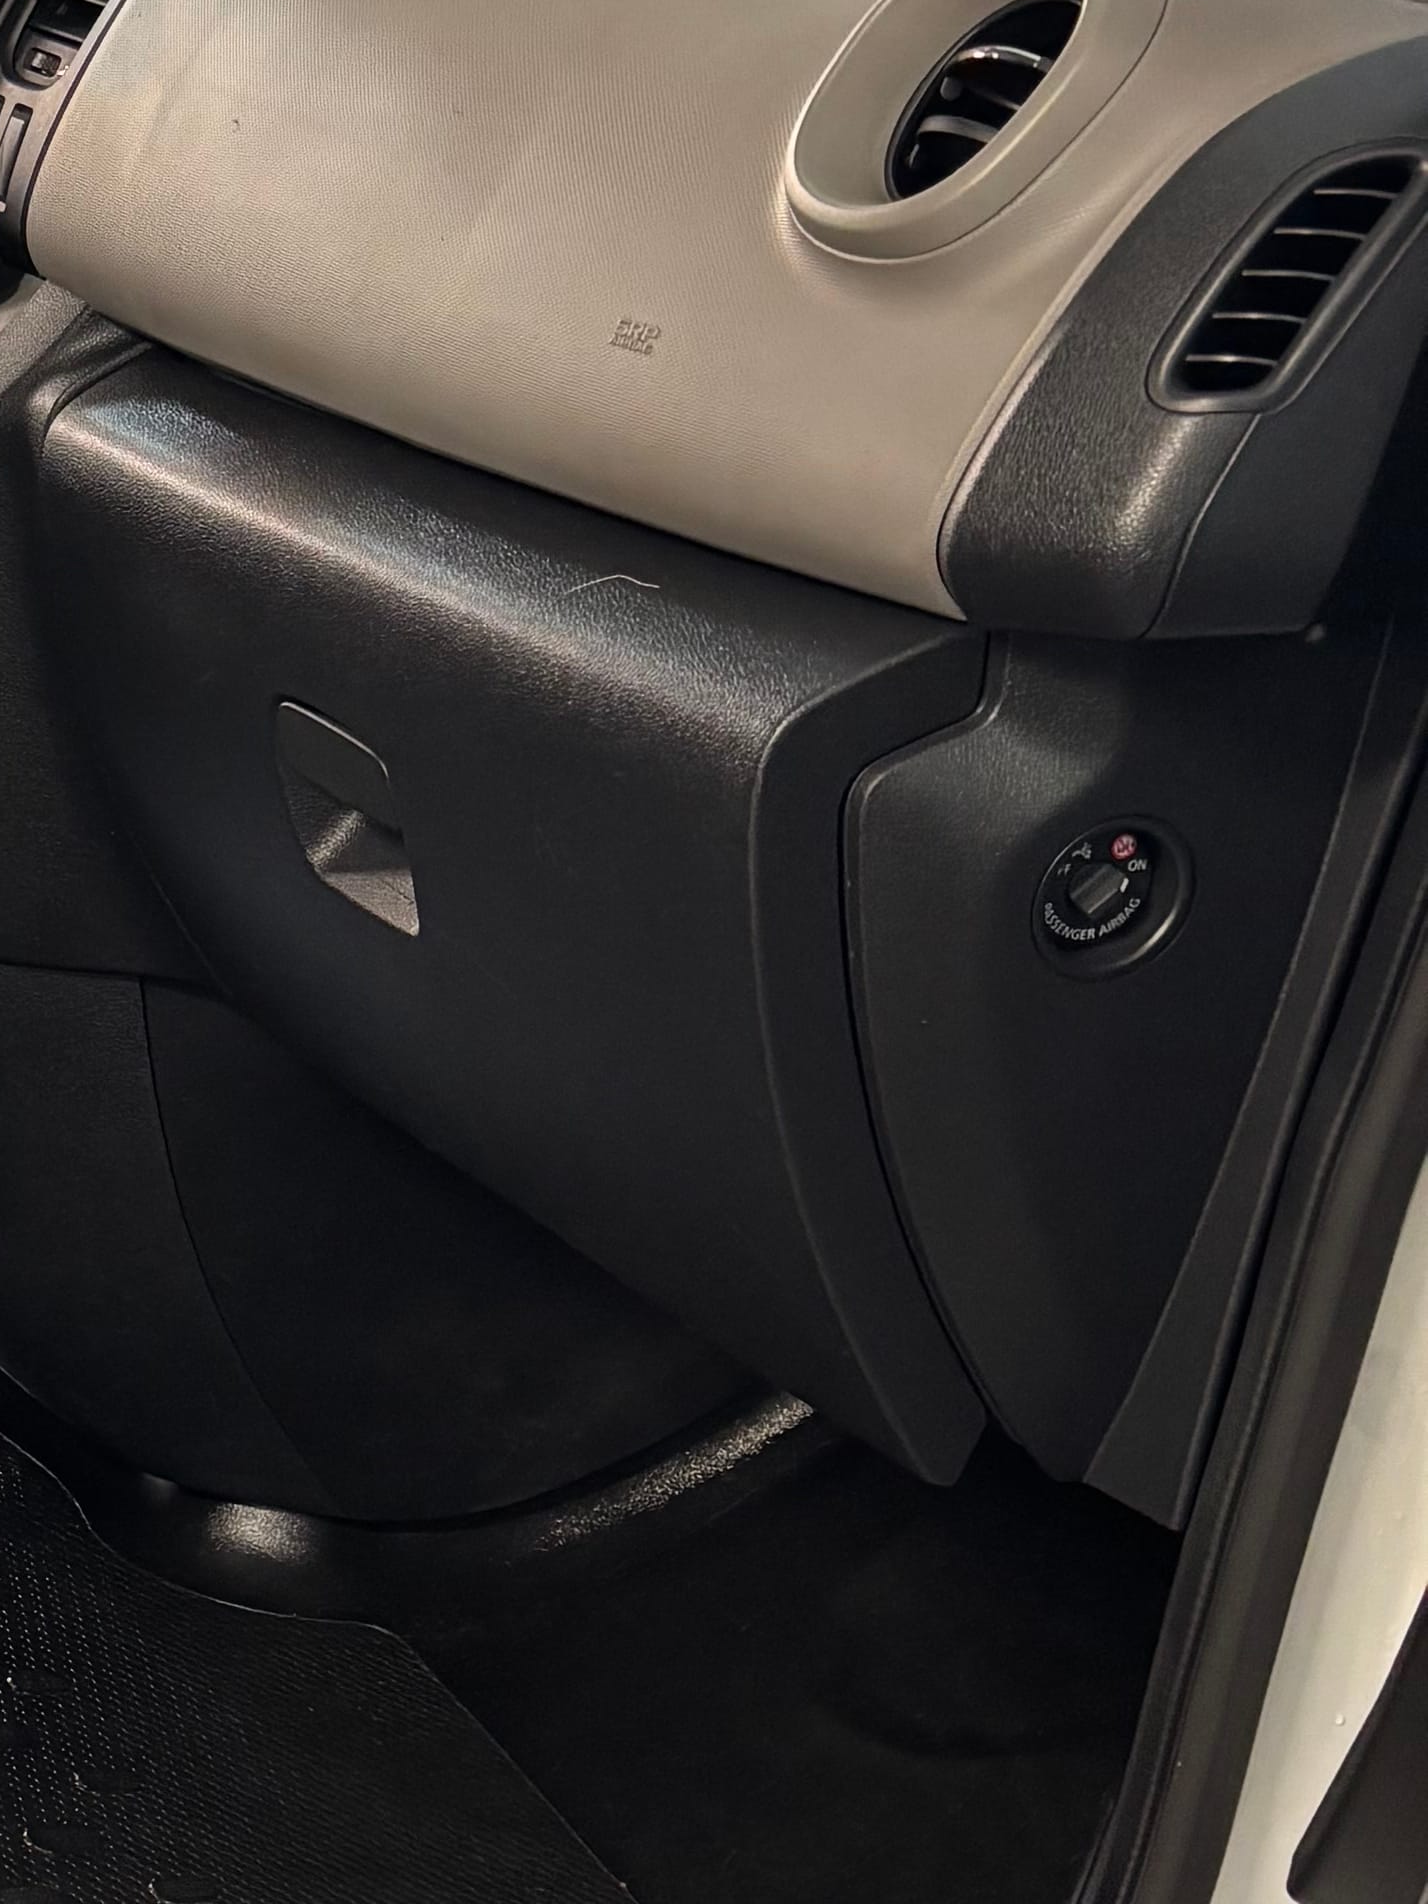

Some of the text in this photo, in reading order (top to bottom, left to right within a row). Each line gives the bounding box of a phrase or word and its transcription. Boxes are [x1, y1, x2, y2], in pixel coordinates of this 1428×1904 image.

[1127, 858, 1147, 872] ON
[1044, 897, 1142, 941] PASSENGER AIRBAG
